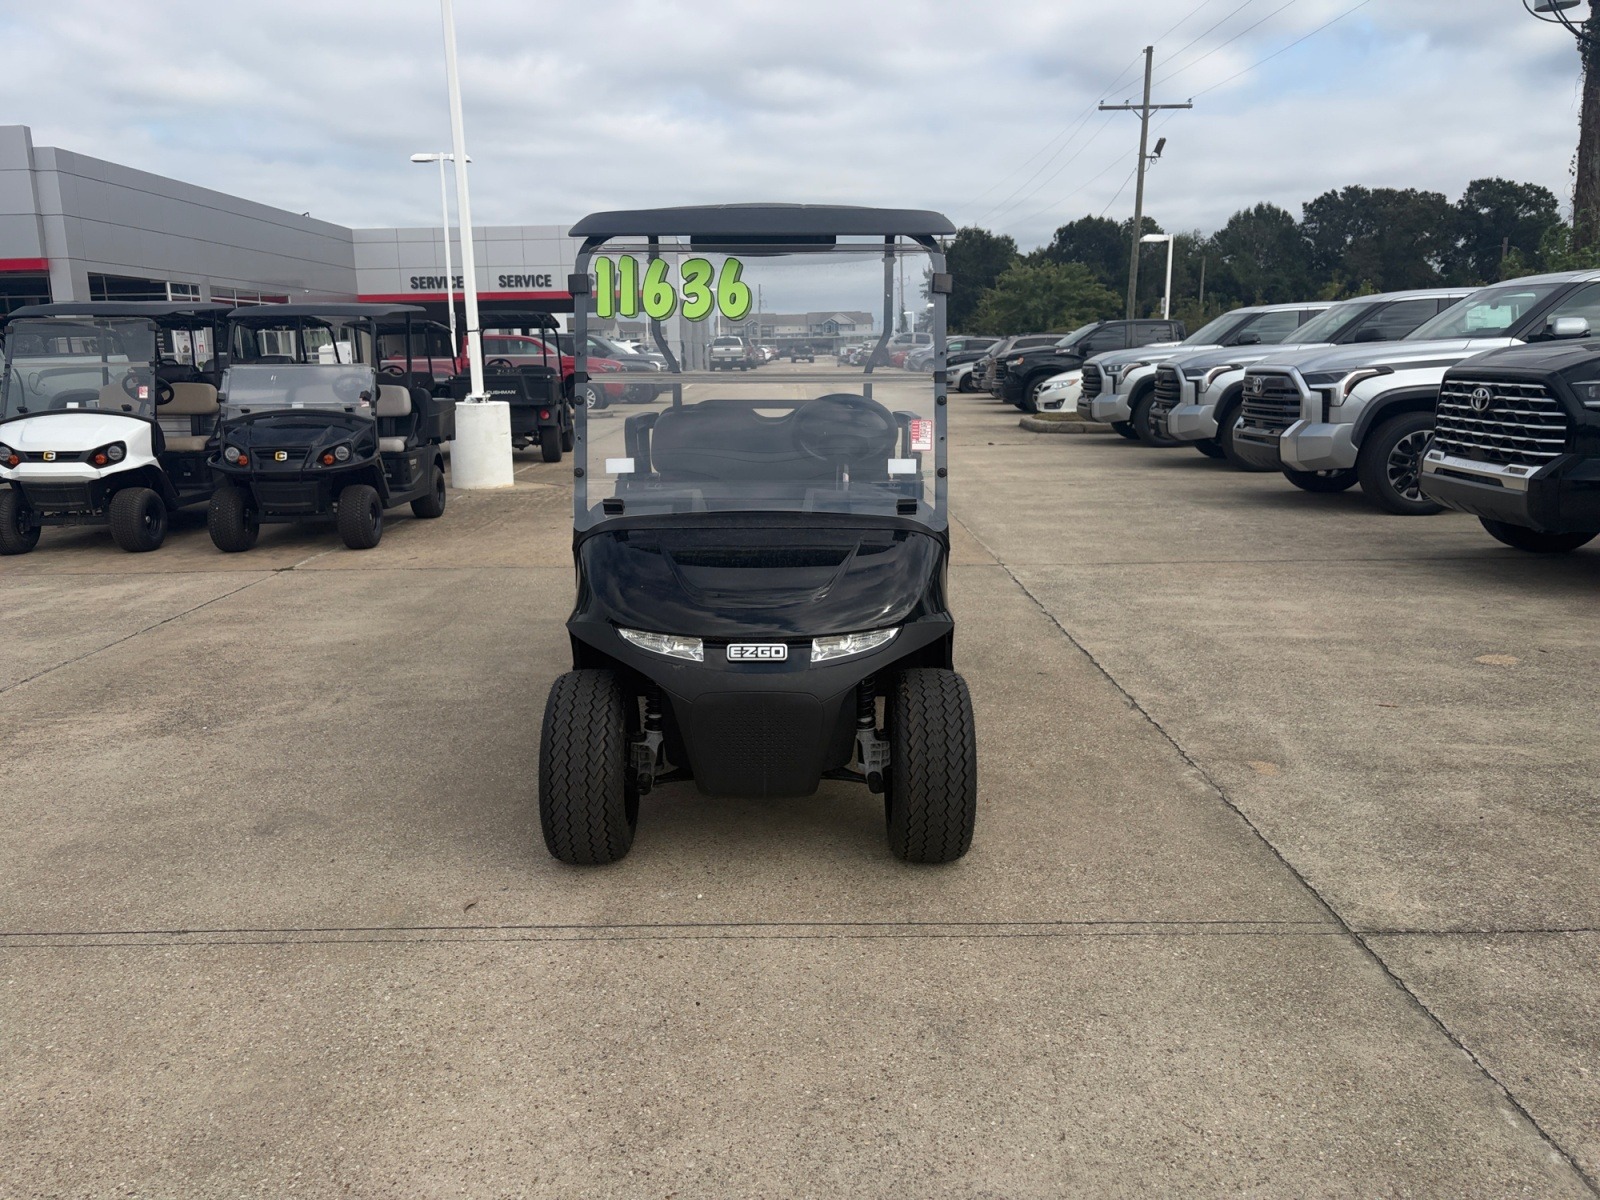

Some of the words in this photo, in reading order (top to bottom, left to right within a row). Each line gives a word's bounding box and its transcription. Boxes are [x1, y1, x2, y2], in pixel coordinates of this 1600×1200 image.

[410, 276, 464, 289] SERVICE
[498, 274, 552, 288] SERVICE
[595, 255, 753, 322] 11636
